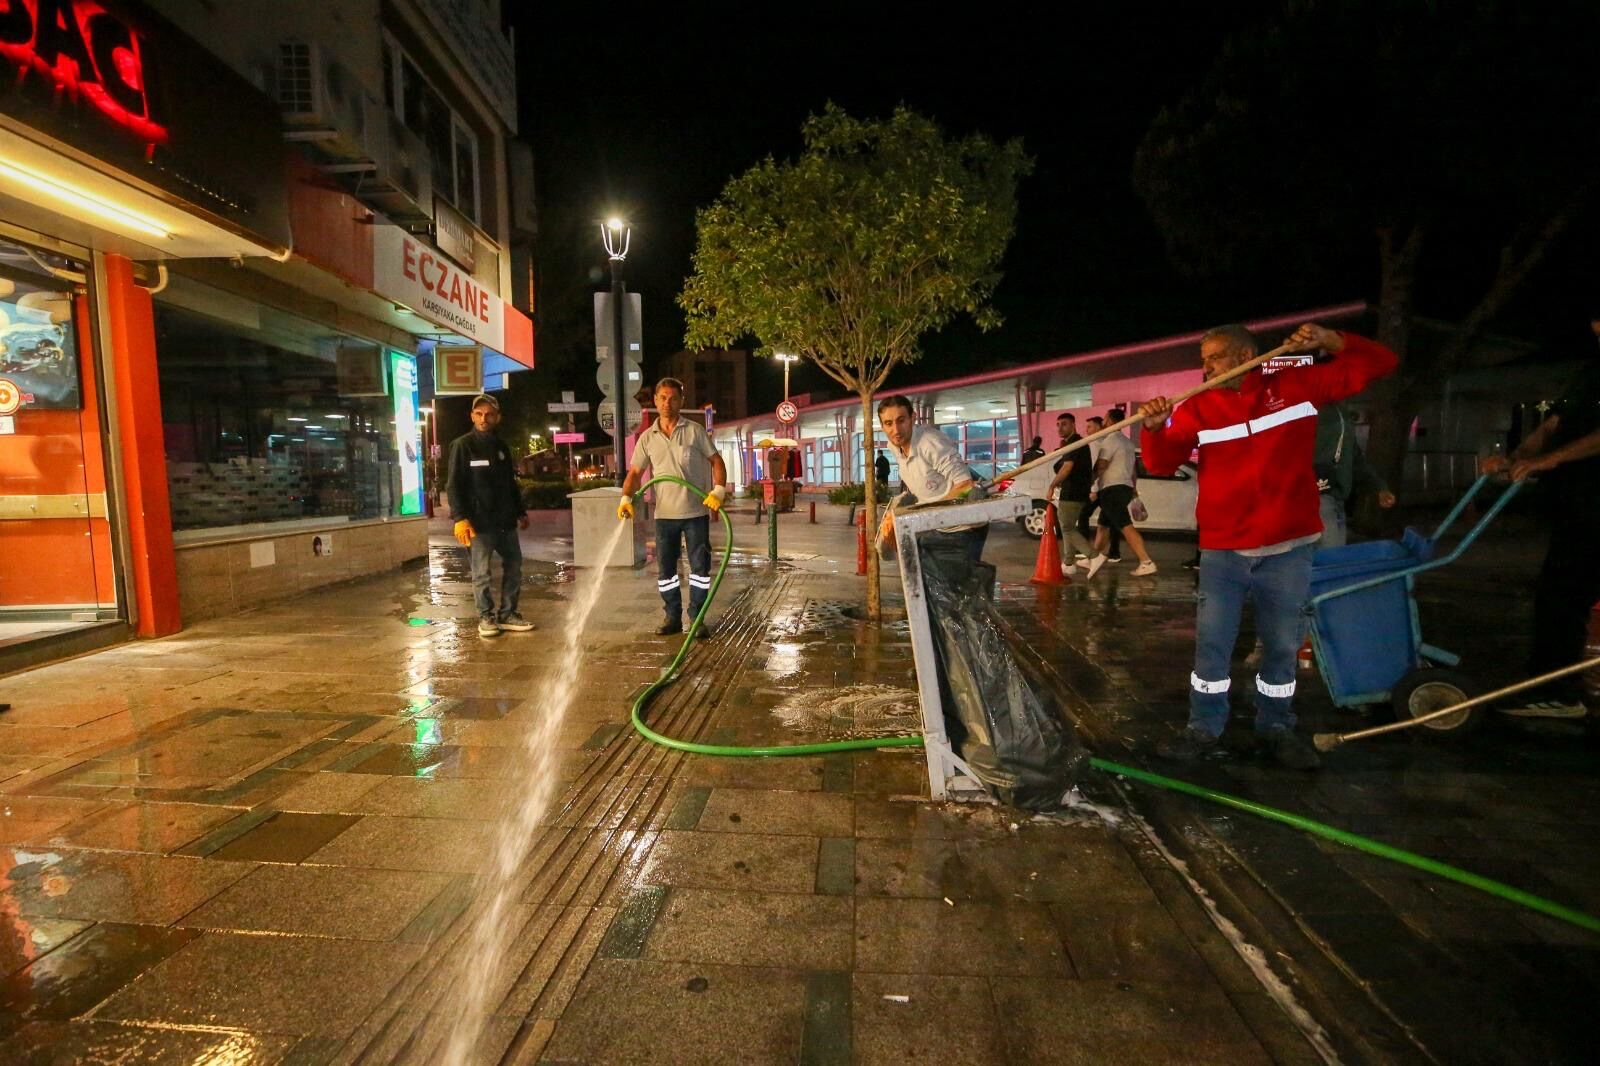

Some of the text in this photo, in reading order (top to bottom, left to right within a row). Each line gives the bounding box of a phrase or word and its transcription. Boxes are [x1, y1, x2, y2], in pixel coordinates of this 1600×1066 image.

[402, 238, 489, 323] ECZANE
[422, 296, 476, 336] KARŞIYAKA ÇAĞDAŞ
[447, 355, 470, 384] E
